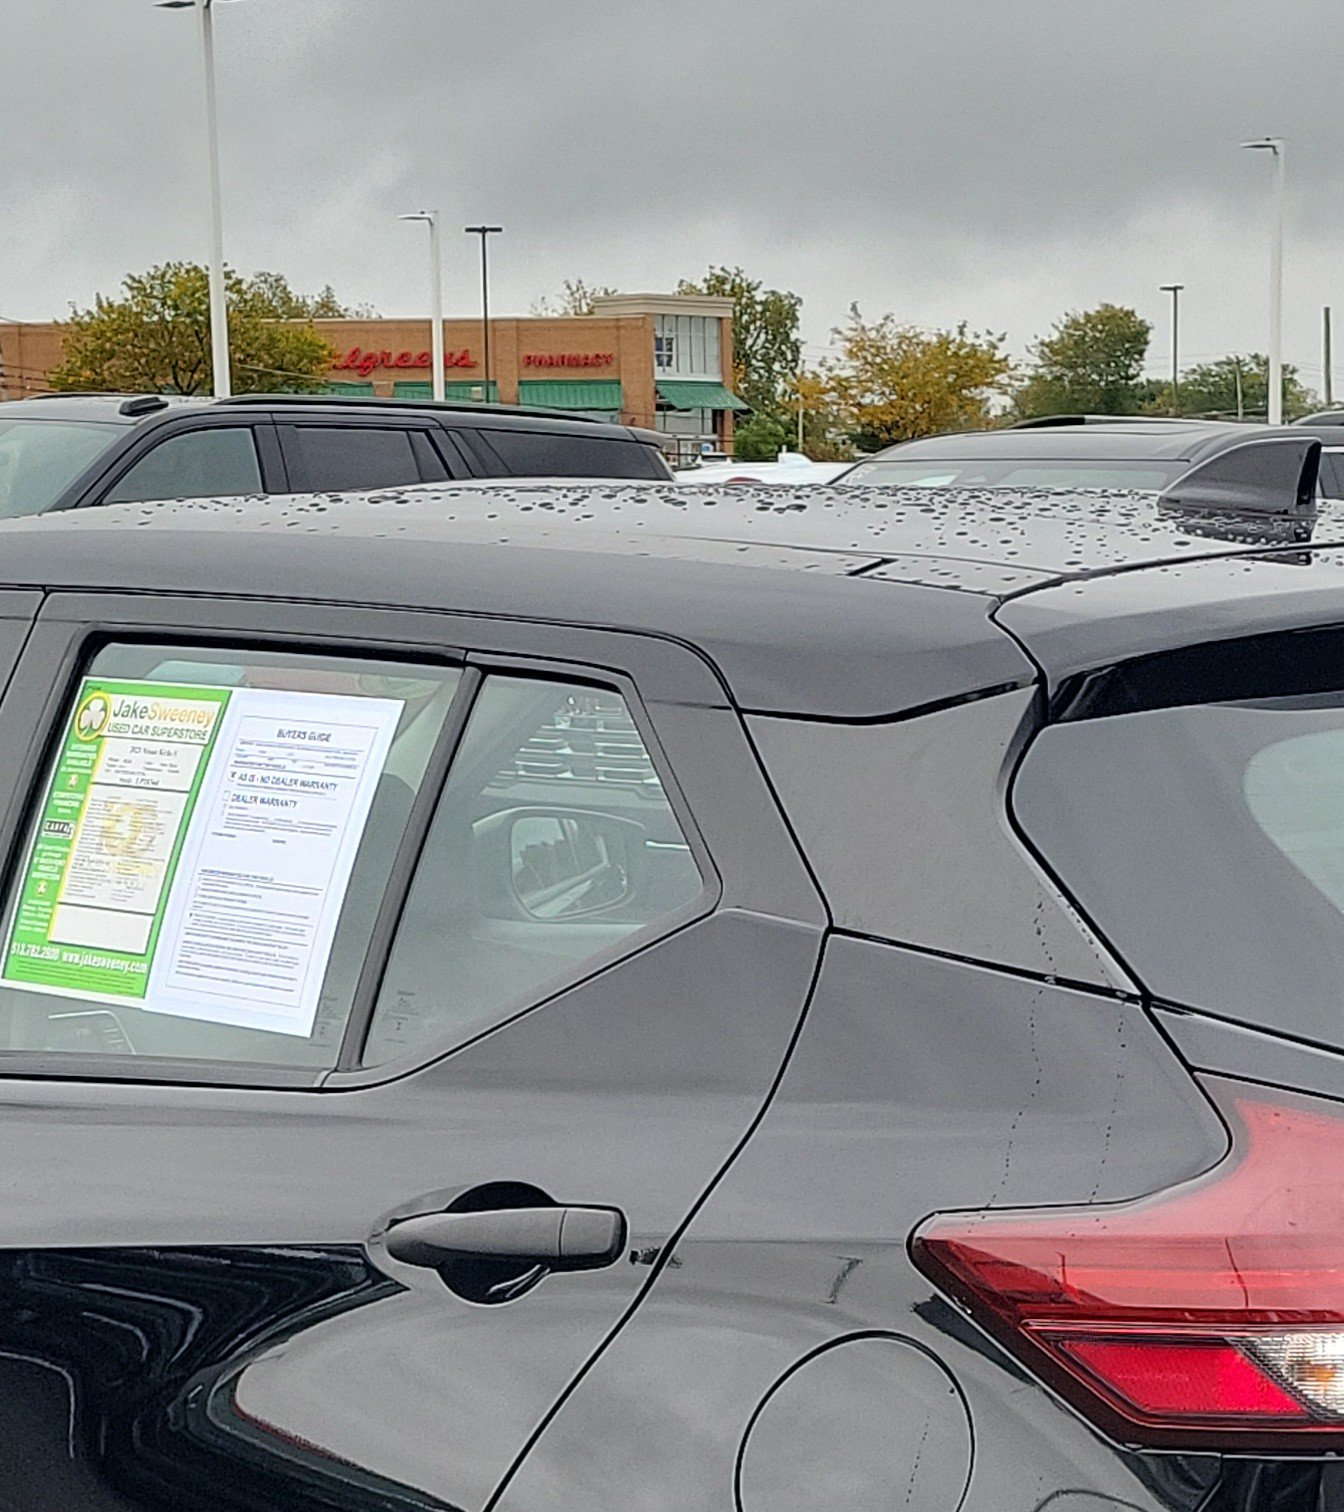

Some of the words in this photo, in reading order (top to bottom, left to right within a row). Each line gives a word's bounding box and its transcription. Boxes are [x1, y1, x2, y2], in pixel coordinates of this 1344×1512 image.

[113, 699, 215, 728] JakeSweeney
[108, 722, 131, 734] USED
[132, 724, 150, 735] CAR
[151, 726, 208, 741] SUPERSTORE
